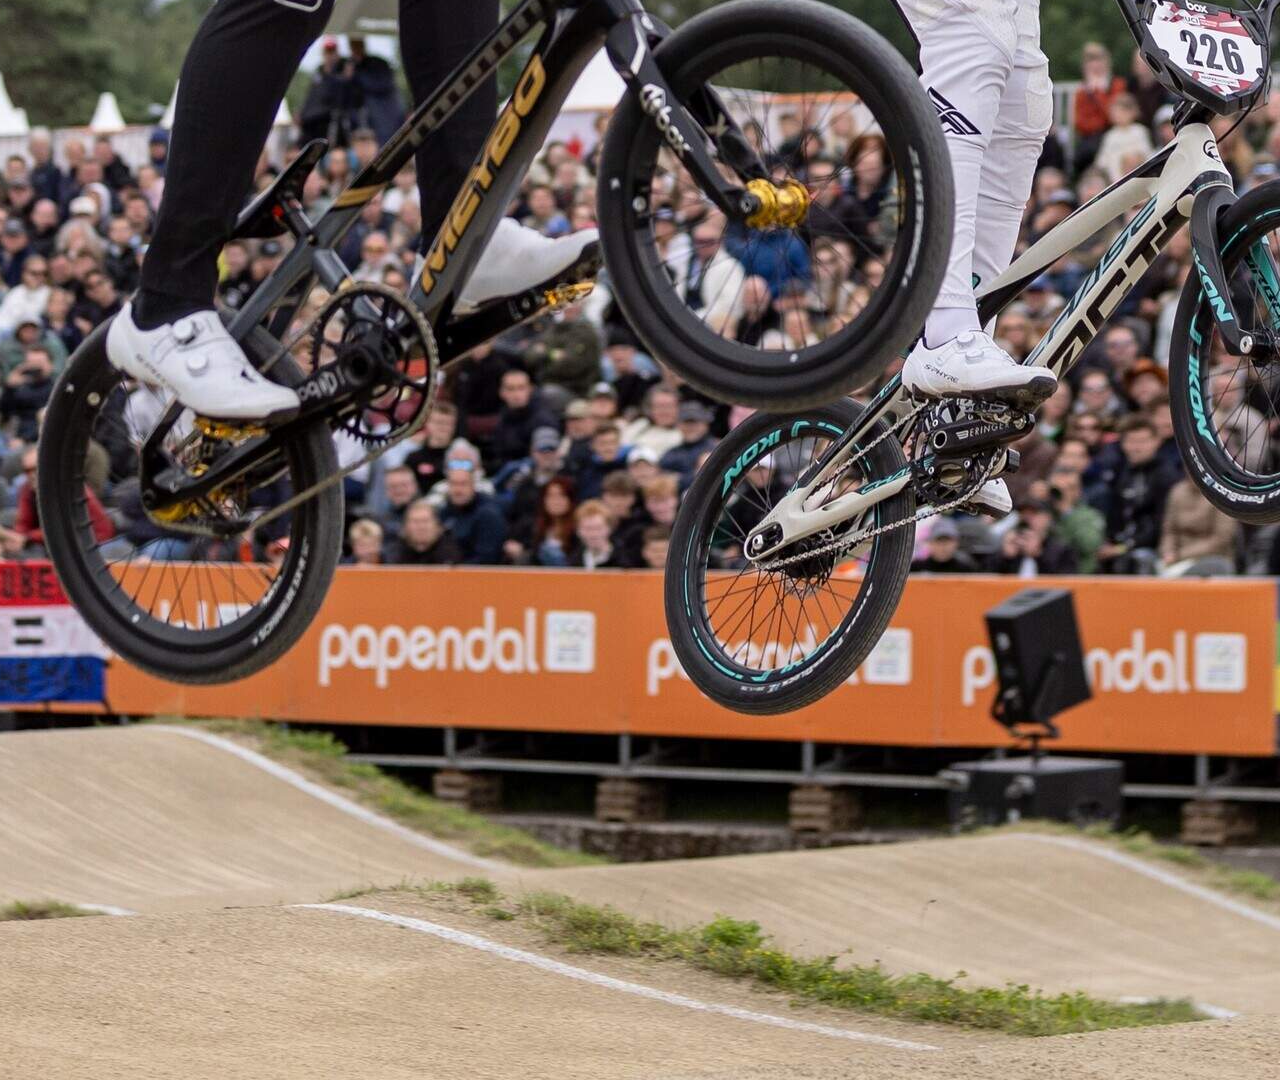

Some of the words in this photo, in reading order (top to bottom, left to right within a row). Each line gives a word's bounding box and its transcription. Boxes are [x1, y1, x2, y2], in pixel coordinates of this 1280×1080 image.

[1185, 0, 1209, 14] box
[1179, 29, 1246, 76] 226
[420, 52, 547, 297] MEYBO
[318, 607, 539, 687] papendal
[961, 629, 1190, 706] pndal
